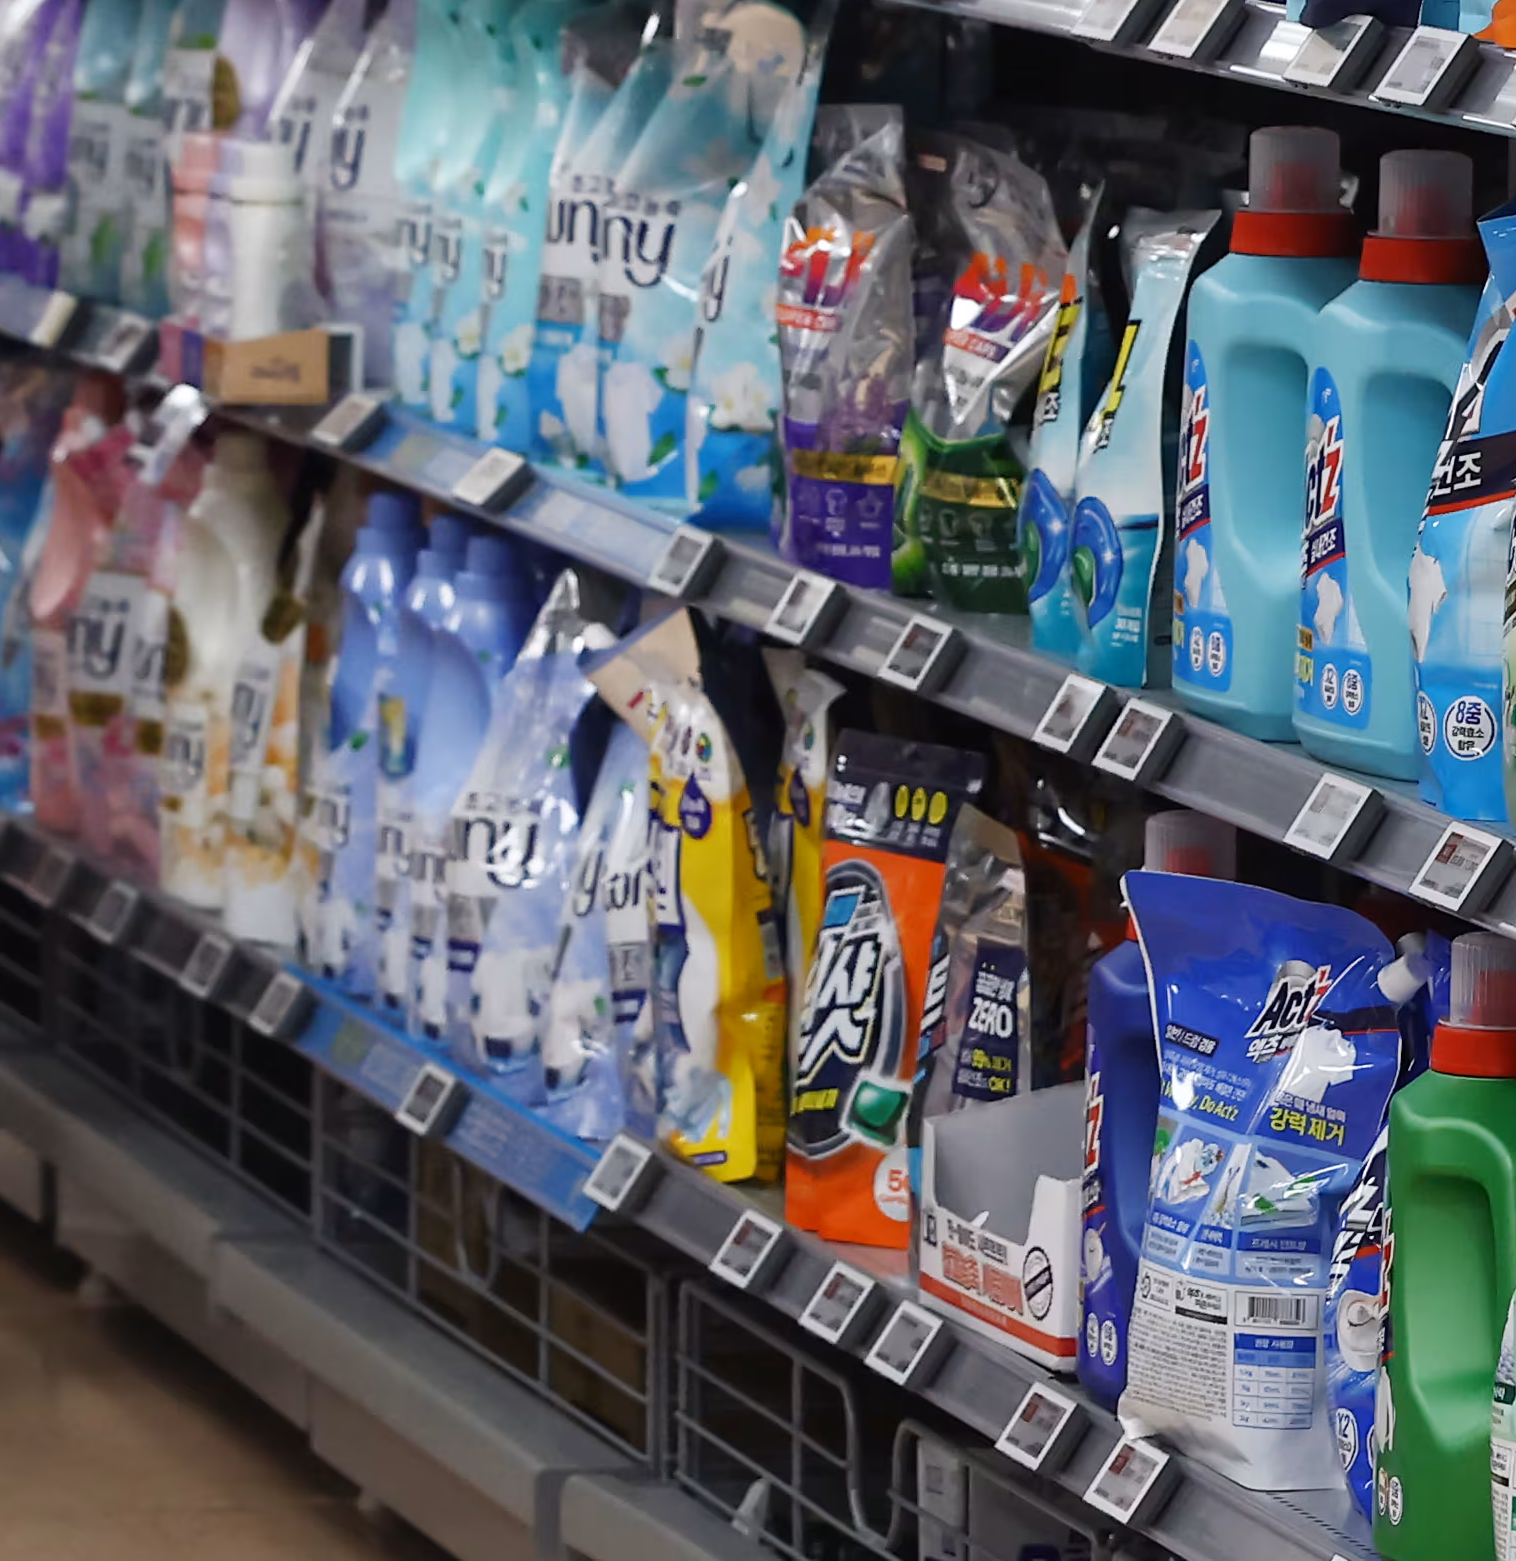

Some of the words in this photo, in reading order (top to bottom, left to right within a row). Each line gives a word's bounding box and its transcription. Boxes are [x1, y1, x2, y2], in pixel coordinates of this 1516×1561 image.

[967, 997, 1014, 1040] ZERO
[1199, 1094, 1216, 1115] Do
[1269, 1105, 1307, 1136] 강력
[1307, 1116, 1345, 1147] 제거
